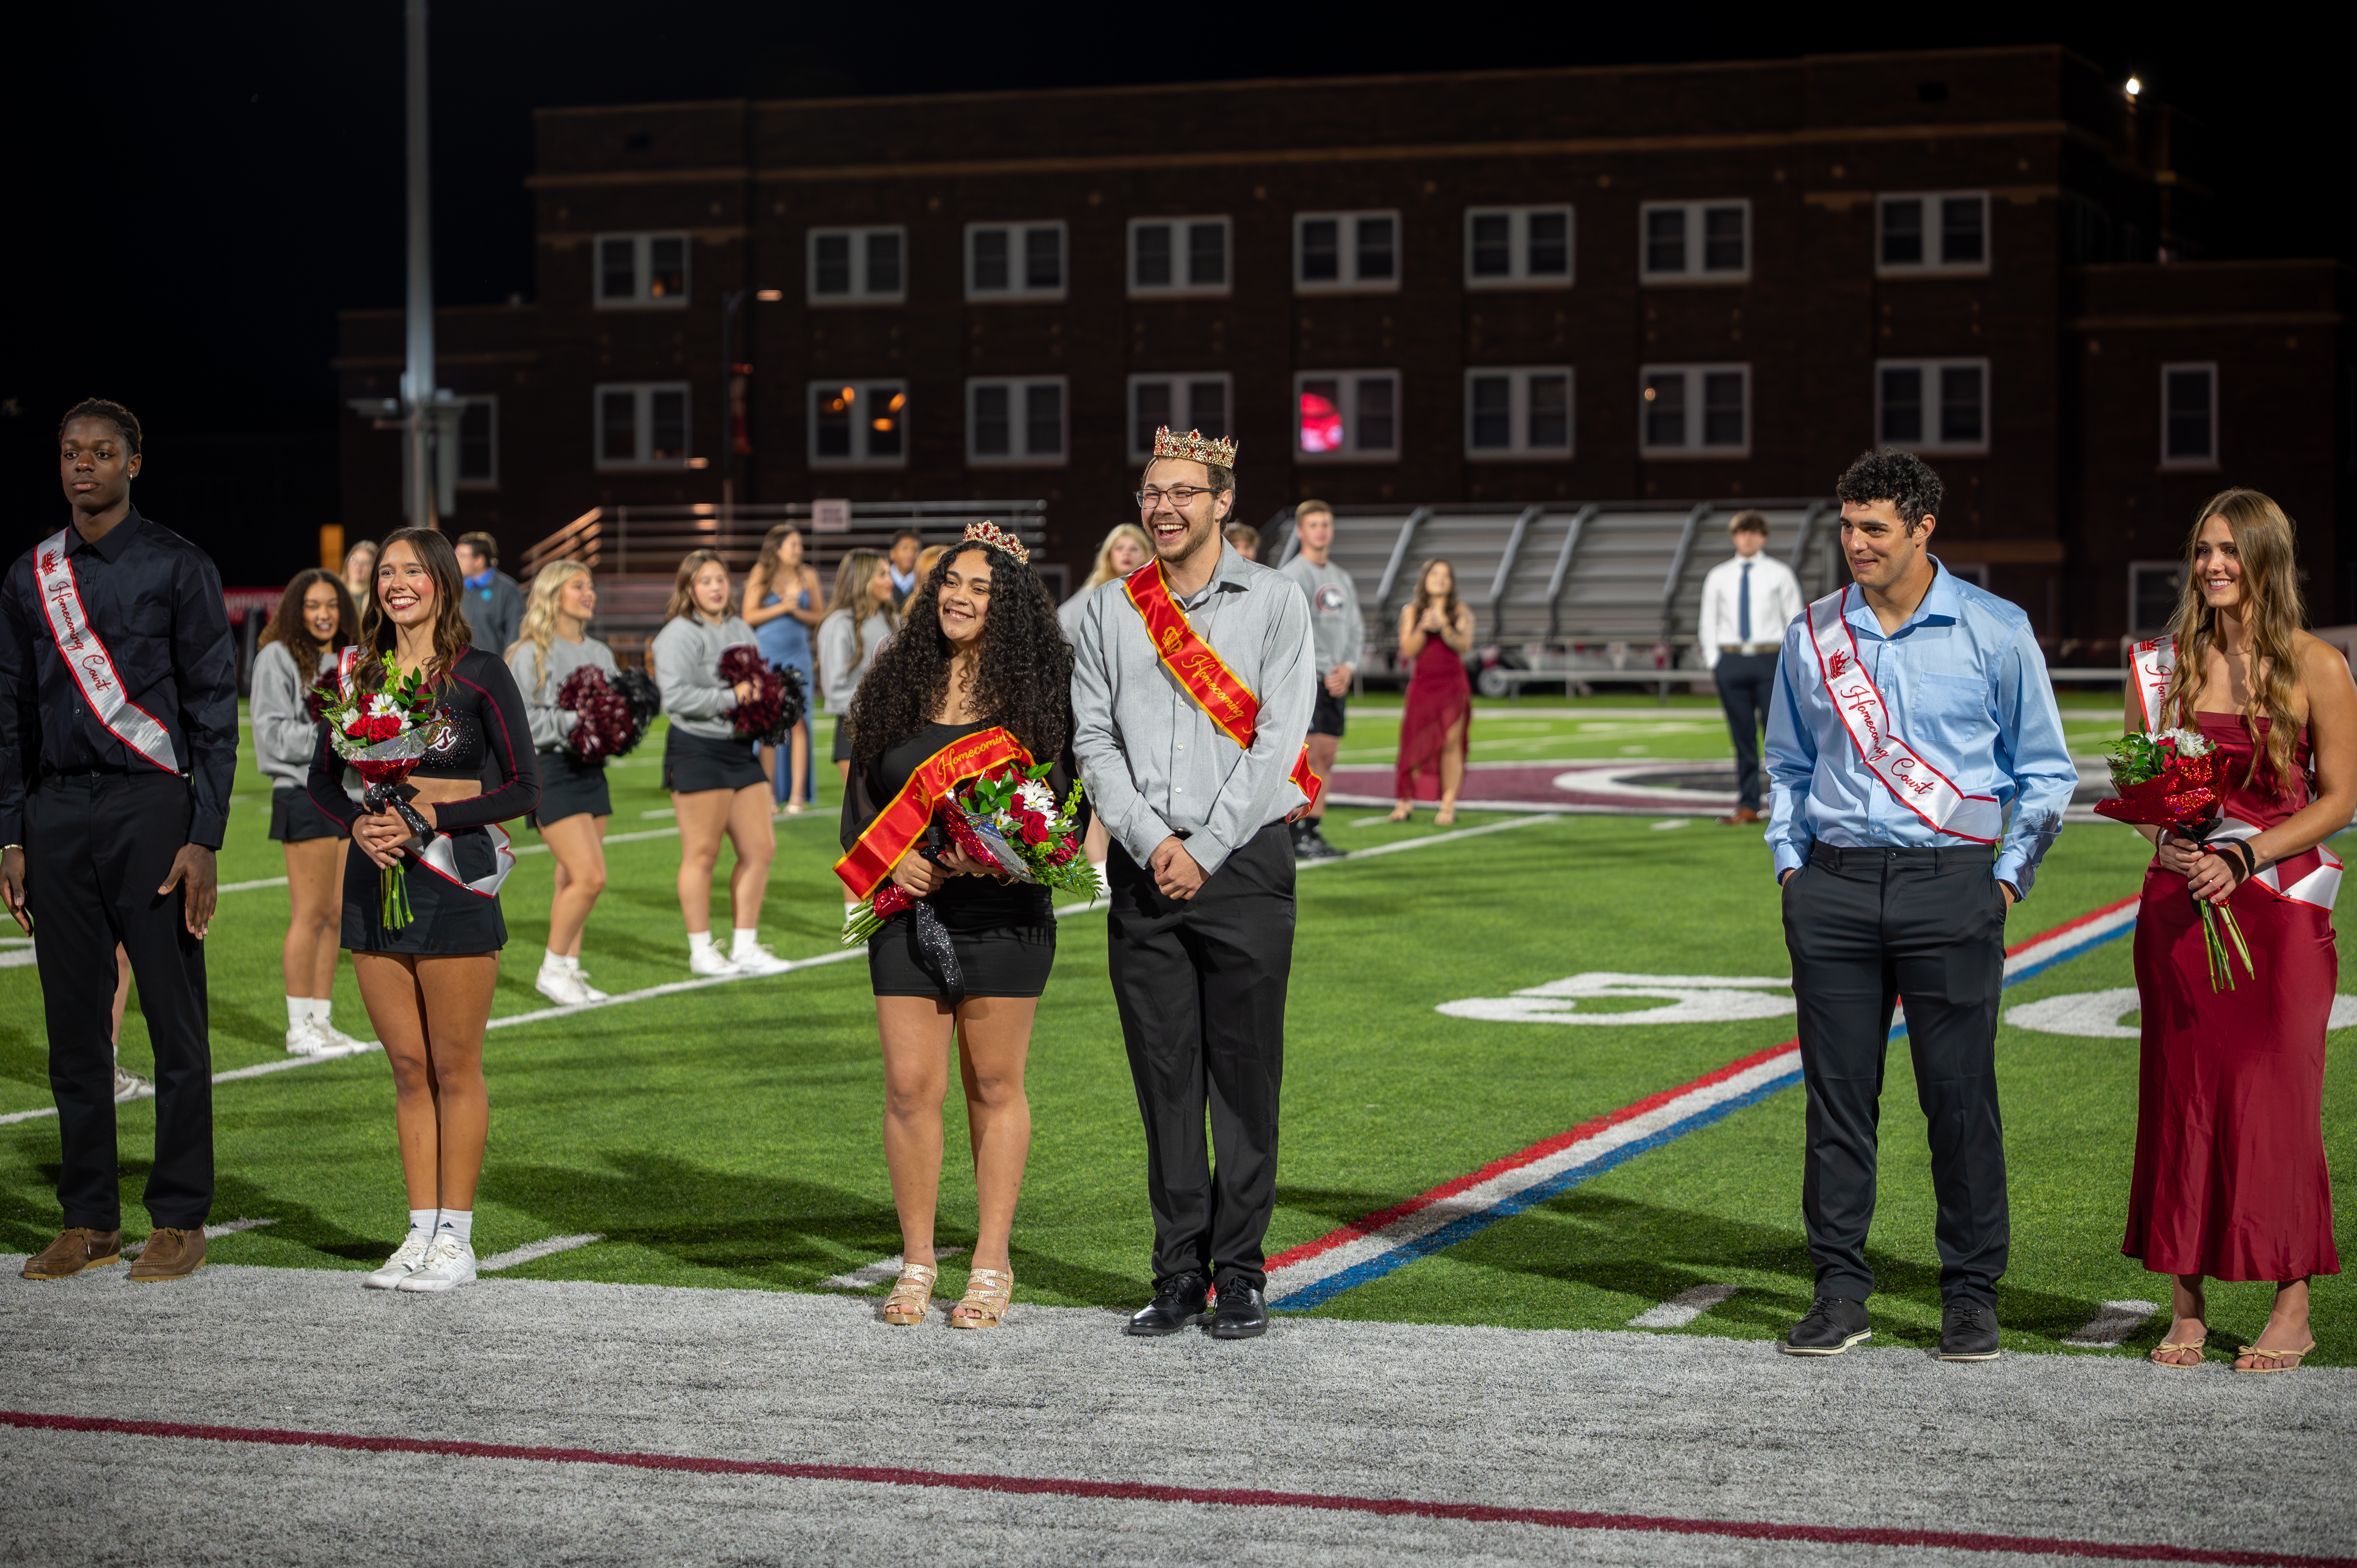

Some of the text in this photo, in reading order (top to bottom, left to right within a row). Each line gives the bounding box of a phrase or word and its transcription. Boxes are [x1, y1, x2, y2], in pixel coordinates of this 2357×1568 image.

[48, 581, 112, 691] Homecoming Court
[1181, 654, 1245, 722] Homecoming
[1891, 758, 1934, 794] Court
